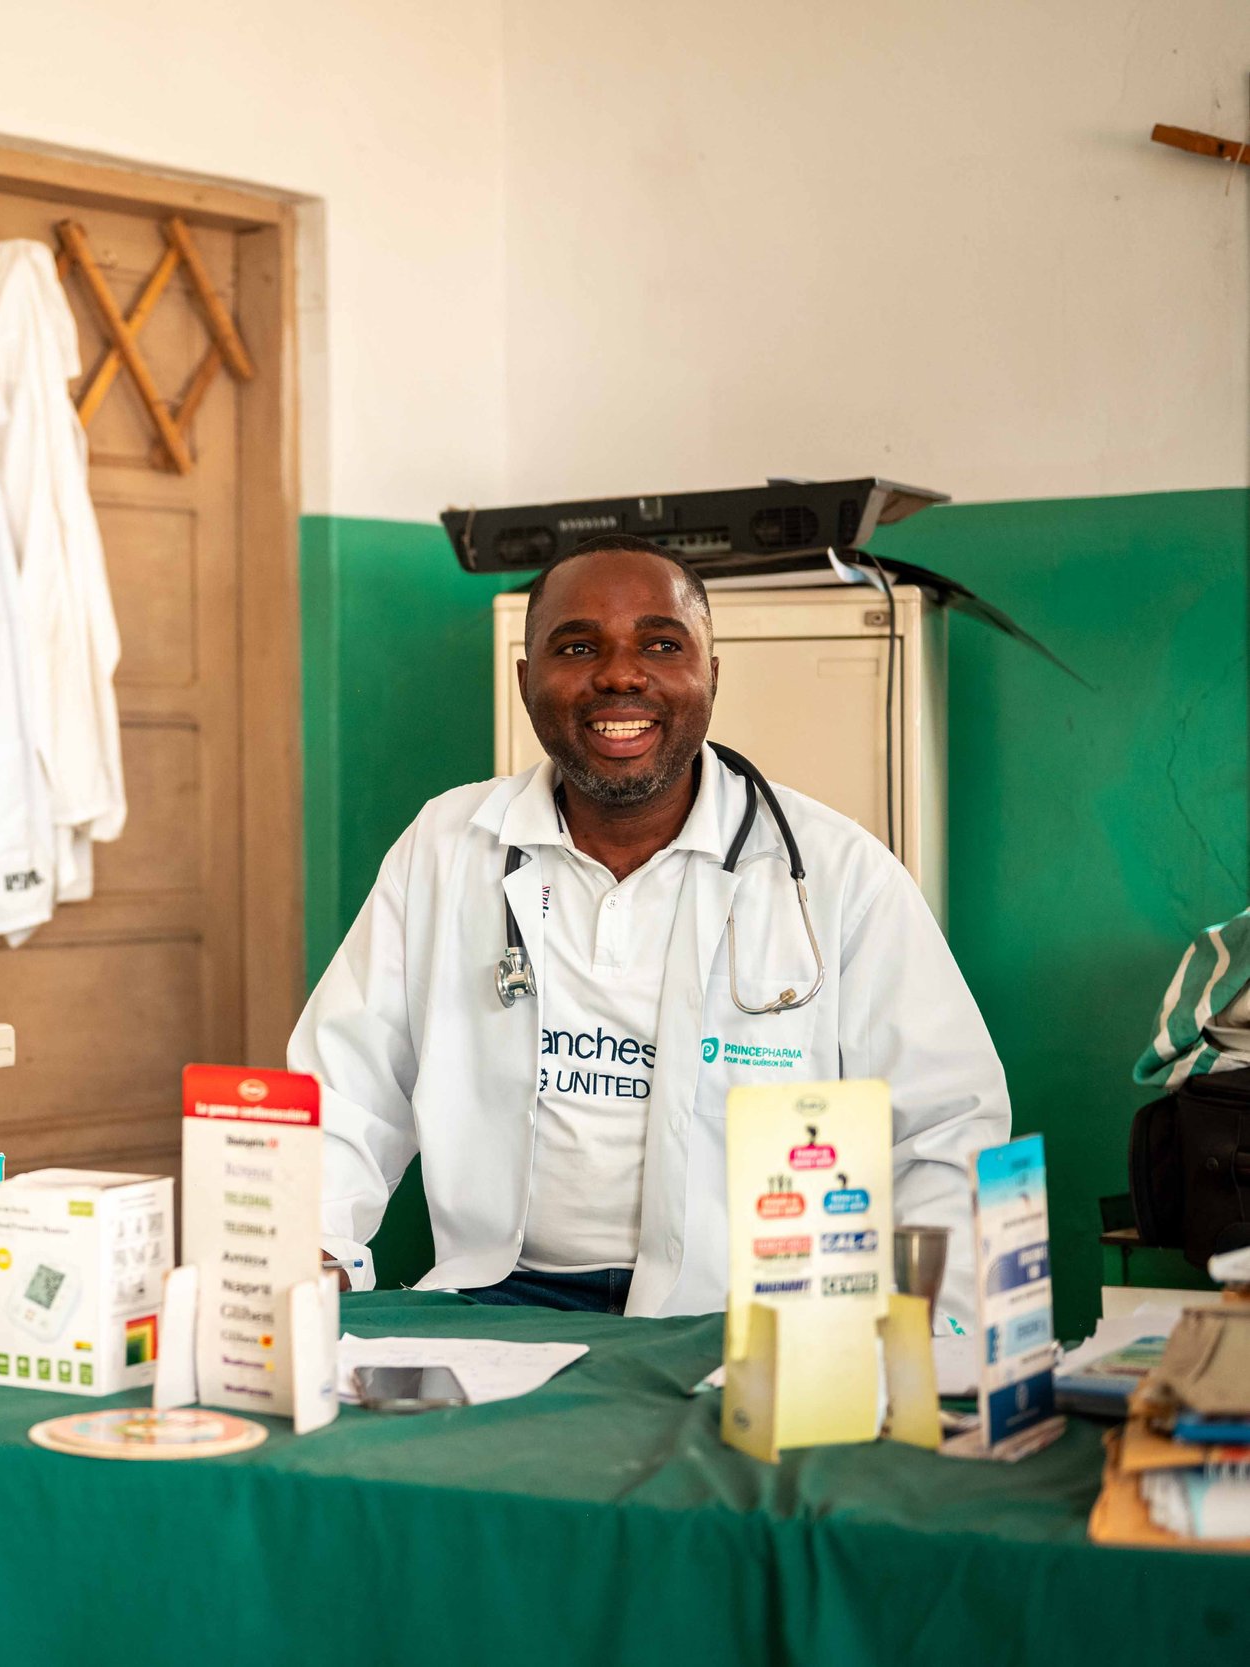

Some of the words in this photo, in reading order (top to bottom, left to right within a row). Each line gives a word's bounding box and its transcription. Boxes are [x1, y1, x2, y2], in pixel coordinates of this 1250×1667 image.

[724, 1043, 803, 1059] PRINCEPHARMA
[723, 1056, 739, 1064] POUR
[739, 1058, 751, 1066] UNE
[556, 1071, 651, 1099] UNITED
